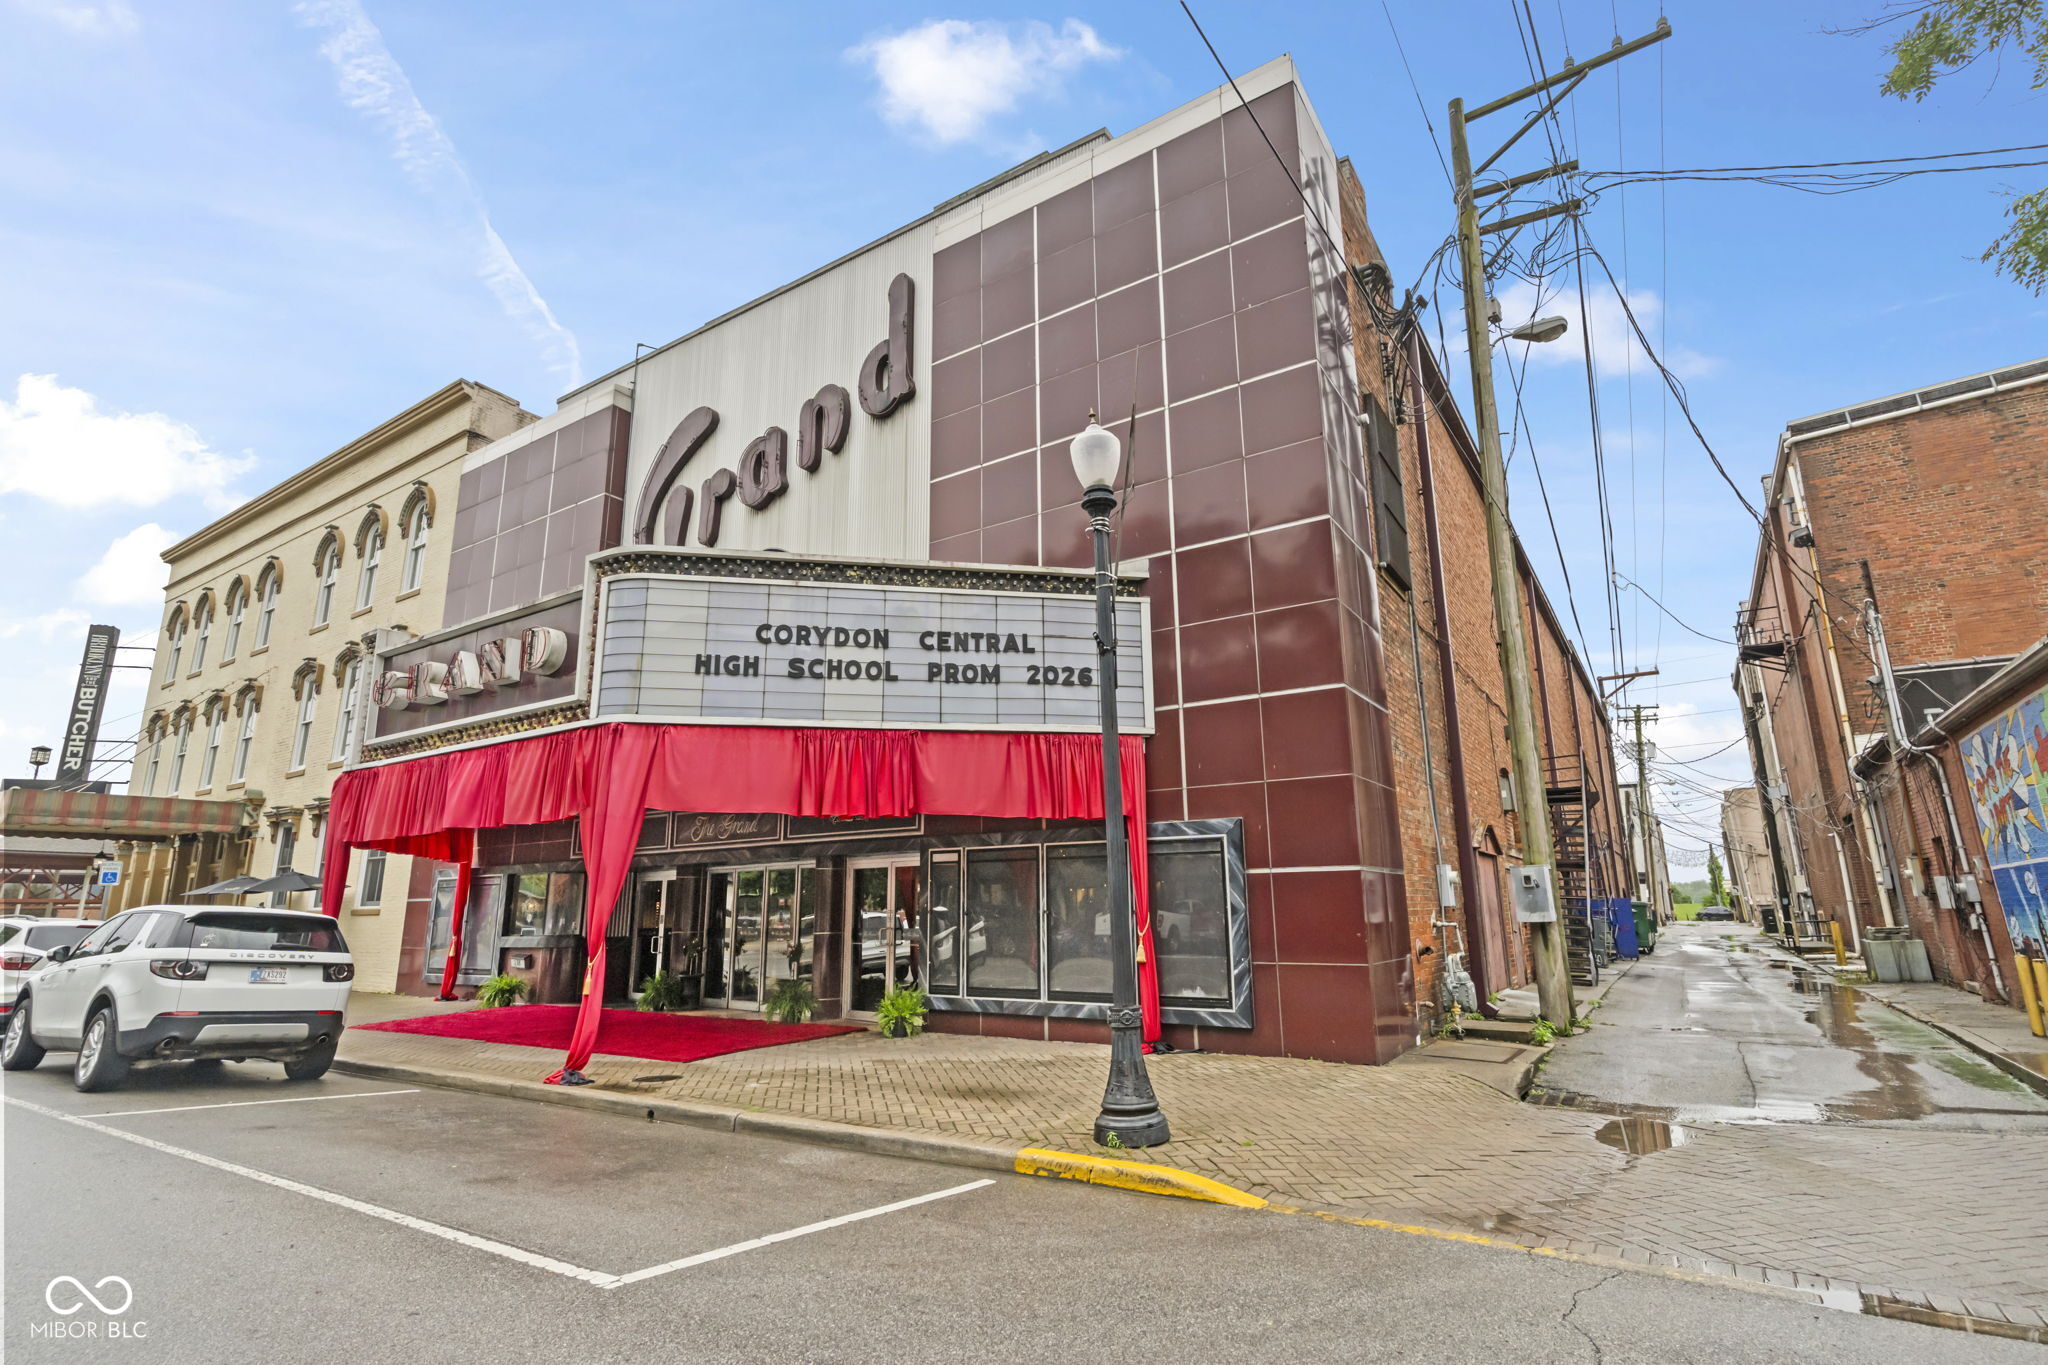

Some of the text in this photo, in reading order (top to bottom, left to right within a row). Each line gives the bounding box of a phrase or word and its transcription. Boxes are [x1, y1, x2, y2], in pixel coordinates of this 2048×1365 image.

[756, 624, 1036, 654] CORYDON CENTRAL
[695, 654, 1094, 687] HIGH SCHOOL PROM 2026
[63, 687, 97, 771] BUTCHER
[690, 814, 761, 842] The Grand
